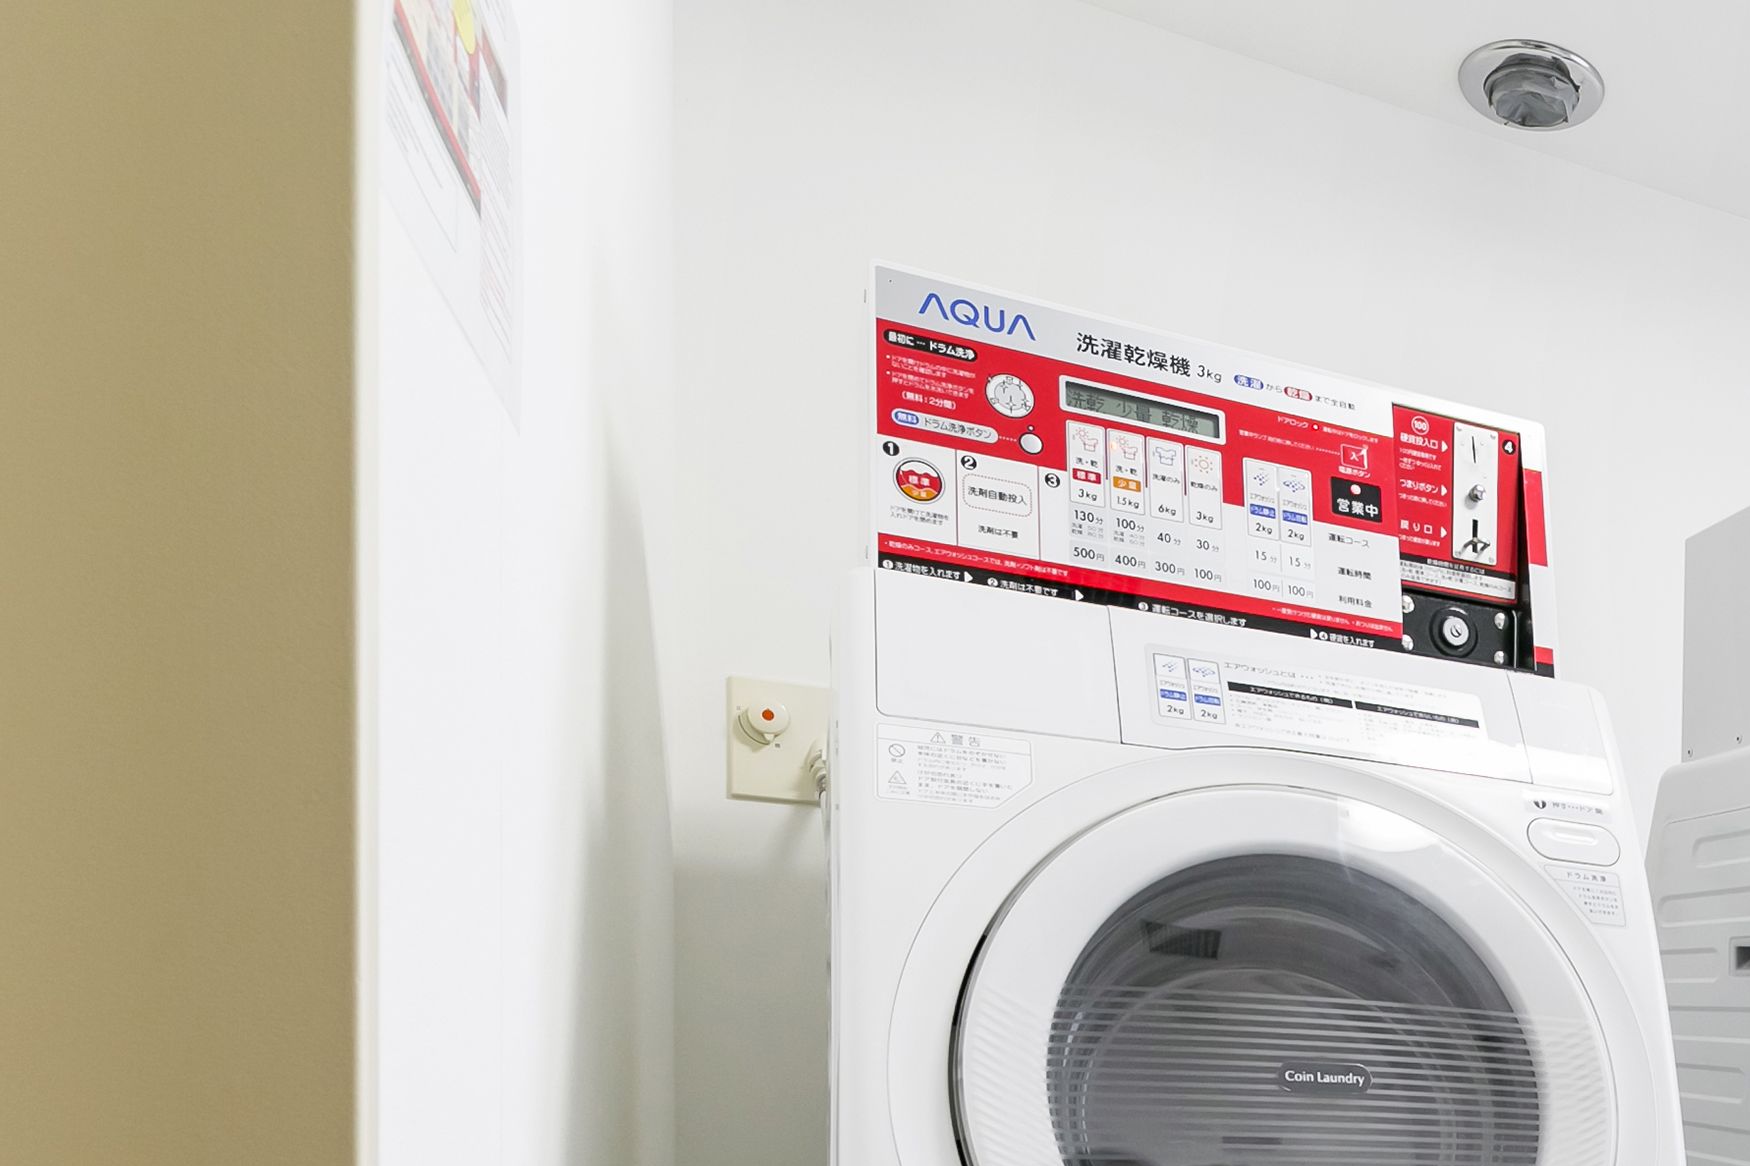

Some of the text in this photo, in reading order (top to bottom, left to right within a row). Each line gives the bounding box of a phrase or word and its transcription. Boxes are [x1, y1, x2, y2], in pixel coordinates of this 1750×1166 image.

[918, 292, 1036, 341] AQUA
[1077, 332, 1222, 384] 洗濯乾燥機 3kg
[924, 417, 992, 439] ドラム洗浄ボタン
[1351, 451, 1359, 461] 入
[968, 486, 1027, 505] 洗剤自動投入
[1078, 488, 1097, 501] 3kg
[1117, 496, 1139, 509] 1.5kg
[1337, 498, 1379, 518] 営業中
[1074, 509, 1103, 525] 130分
[1158, 504, 1176, 516] 6kg
[1196, 511, 1214, 523] 3kg
[978, 525, 1018, 539] 洗剤は不要
[1116, 518, 1145, 532] 100分
[1256, 522, 1272, 535] 2kg
[1288, 529, 1305, 541] 2kg
[1328, 532, 1370, 548] 運転コース
[1073, 547, 1105, 562] 500円
[1115, 554, 1146, 569] 400円
[1155, 561, 1185, 576] 300円
[1194, 568, 1222, 583] 100円
[1338, 567, 1372, 580] 運転時間
[1253, 579, 1280, 593] 100円
[1288, 585, 1314, 599] 100円
[1339, 595, 1372, 608] 利用料金
[1167, 704, 1184, 715] 2kg
[1201, 710, 1218, 719] 2kg
[1284, 1070, 1364, 1087] Coin Laundry
